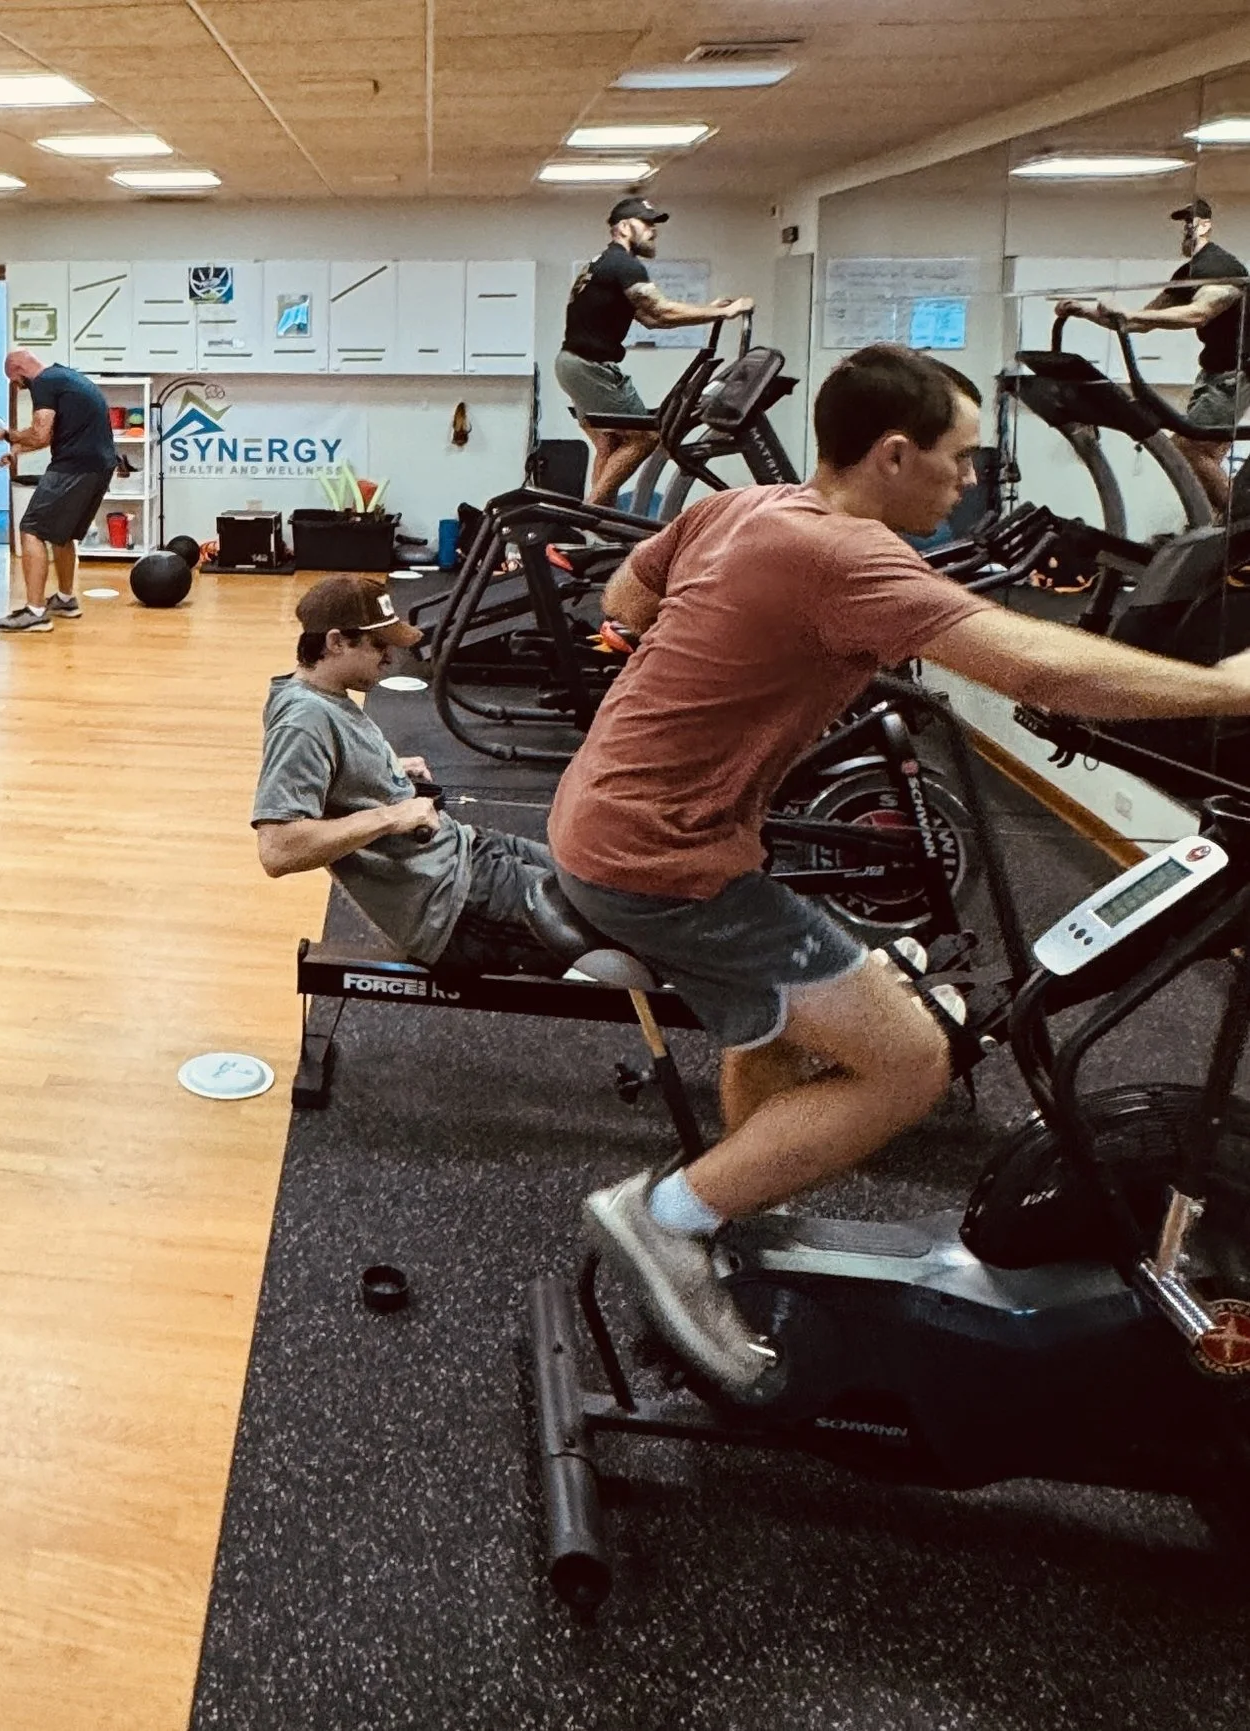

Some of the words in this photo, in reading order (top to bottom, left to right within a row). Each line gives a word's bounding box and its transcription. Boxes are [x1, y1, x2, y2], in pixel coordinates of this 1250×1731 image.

[169, 437, 343, 463] SYNERGY
[169, 465, 224, 475] HEALTH
[229, 465, 259, 475] AND
[343, 972, 419, 996] FORCE
